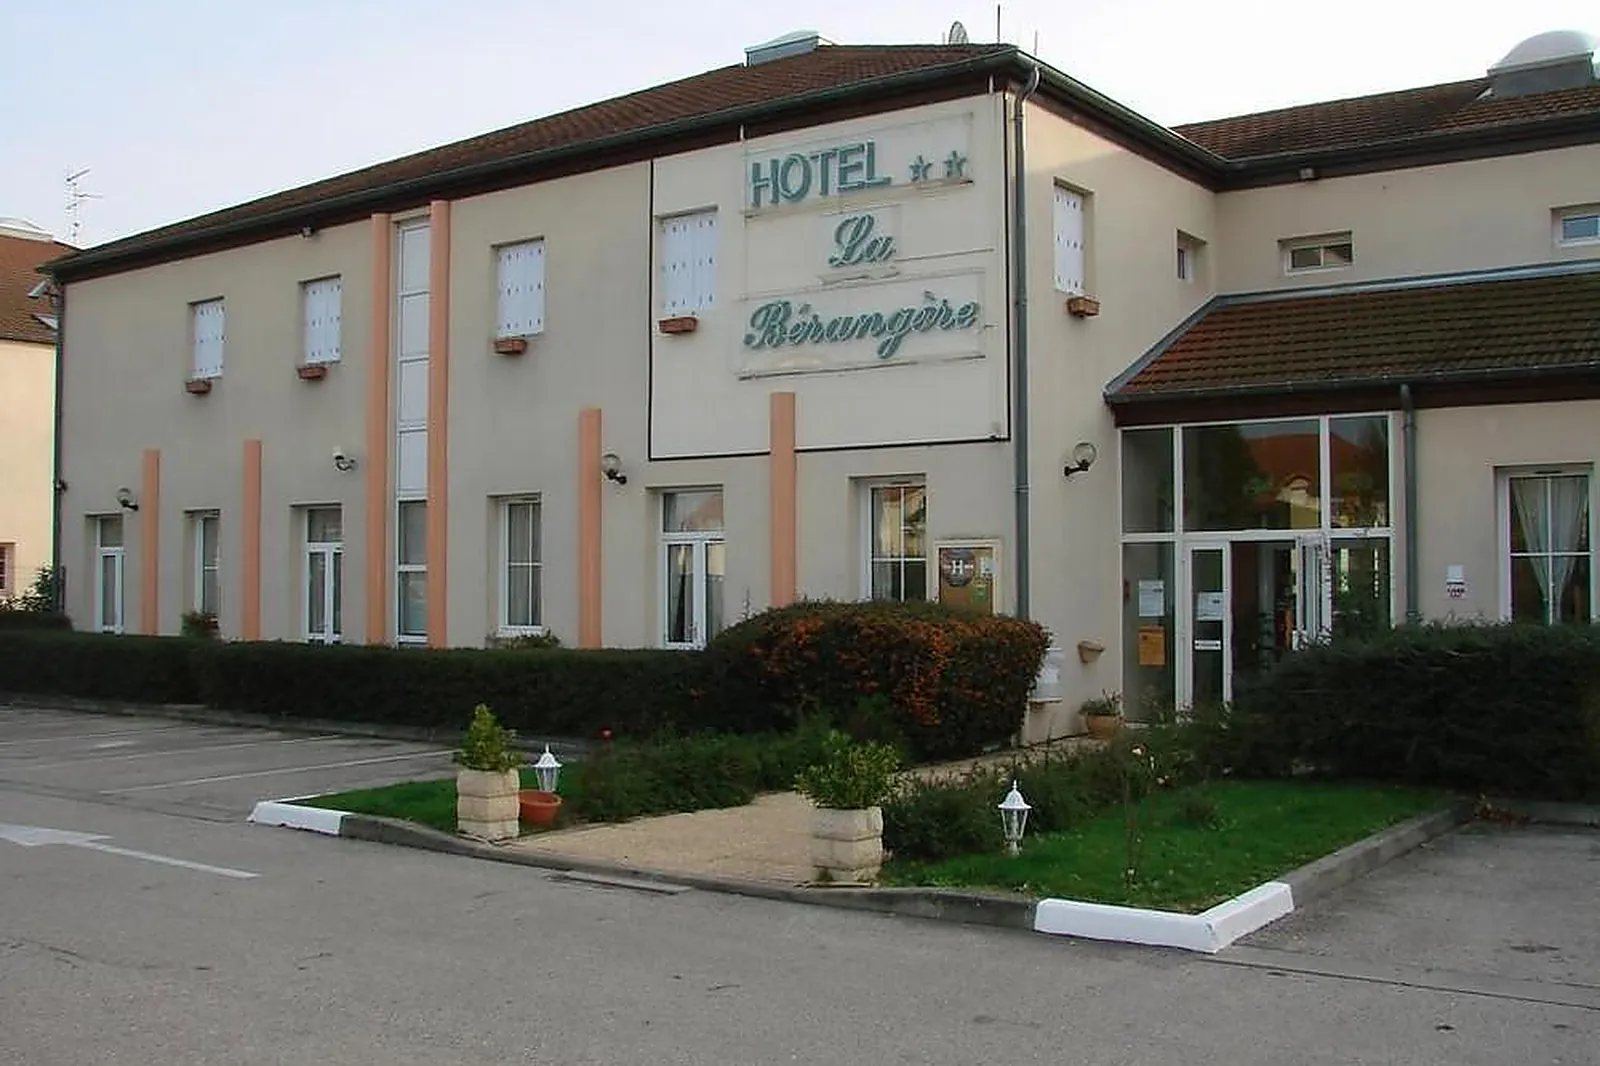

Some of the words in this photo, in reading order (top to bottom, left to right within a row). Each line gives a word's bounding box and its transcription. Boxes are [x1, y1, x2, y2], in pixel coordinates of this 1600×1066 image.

[751, 141, 892, 208] HOTEL
[828, 213, 896, 267] La
[743, 290, 980, 359] Bérangère
